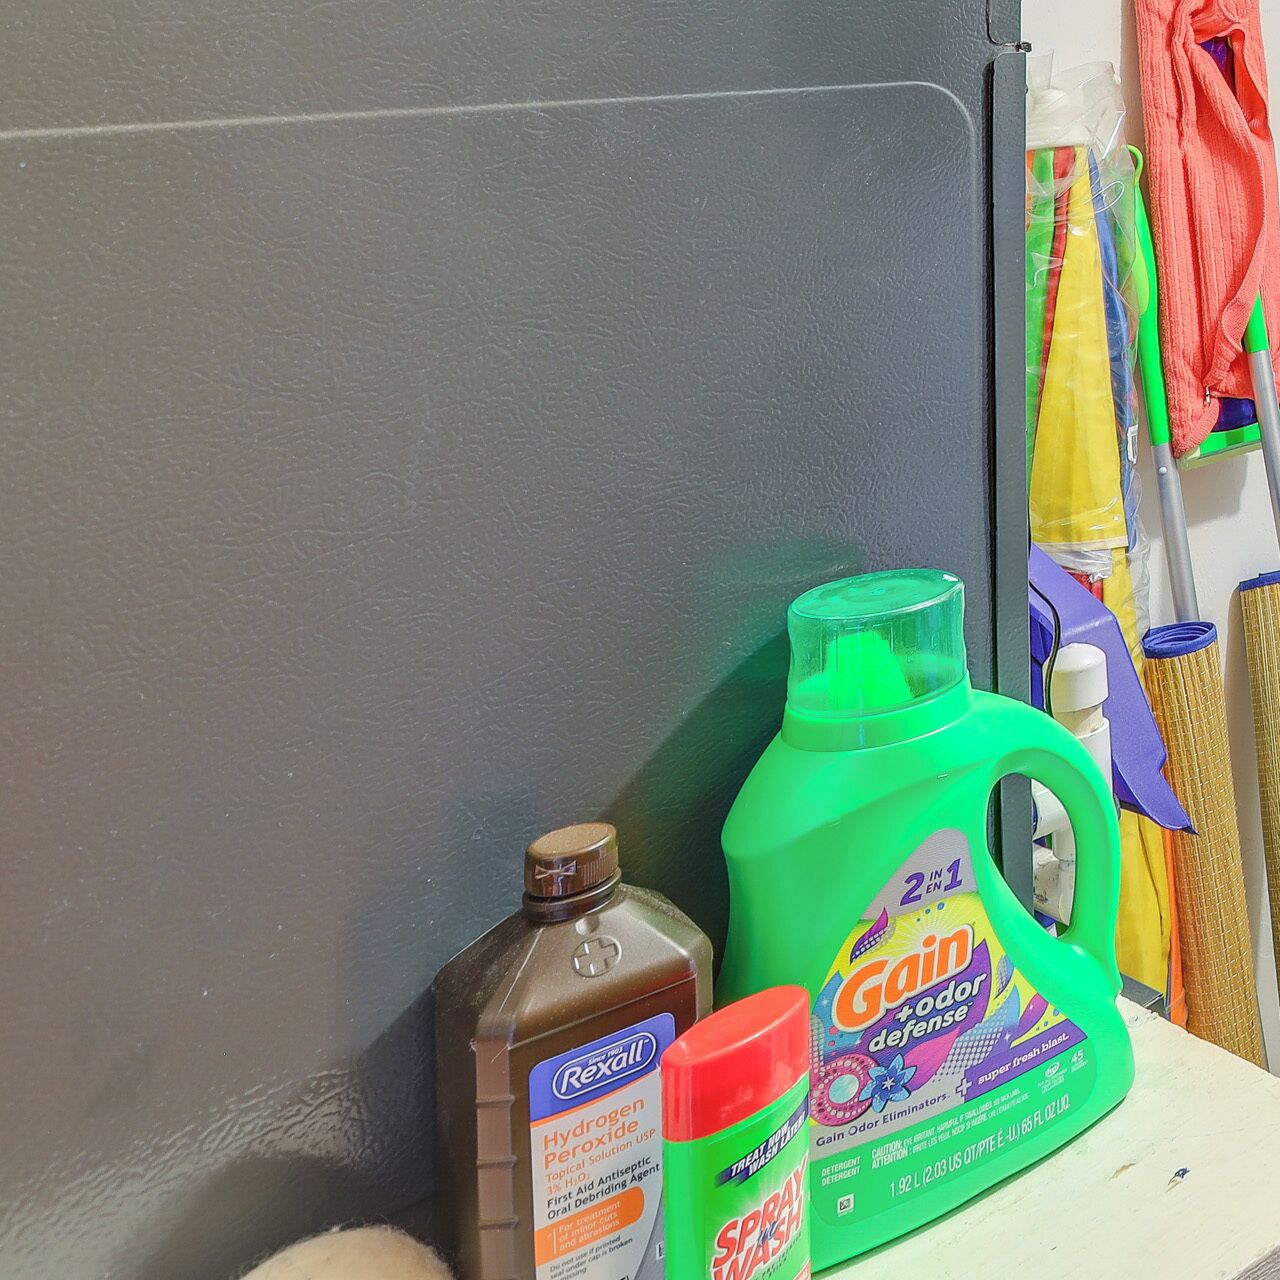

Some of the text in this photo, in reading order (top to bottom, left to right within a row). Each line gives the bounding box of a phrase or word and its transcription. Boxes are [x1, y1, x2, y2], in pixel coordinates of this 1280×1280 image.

[900, 871, 924, 906] 2
[926, 881, 942, 894] EN
[929, 868, 943, 882] IN
[944, 858, 963, 892] 1
[834, 926, 971, 1030] Gain
[868, 1004, 969, 1053] defense
[560, 1039, 644, 1094] Rexall
[978, 1063, 1013, 1084] super
[1011, 1047, 1041, 1068] fresh
[1071, 1049, 1084, 1064] 45
[544, 1098, 645, 1151] Hydrogen
[816, 1132, 845, 1147] Gain
[848, 1119, 880, 1136] Odor
[882, 1094, 947, 1124] Eliminators
[545, 1121, 640, 1170] Peroxide
[546, 1128, 656, 1183] Topical Solution USP
[730, 1144, 766, 1177] TREAT
[748, 1143, 778, 1176] WASH
[871, 1139, 902, 1159] CAUTION:
[871, 1146, 908, 1170] ATTENTION
[890, 1175, 912, 1198] 1.92
[914, 1172, 920, 1188] L
[922, 1159, 947, 1186] (2.03
[949, 1150, 961, 1171] US
[964, 1134, 996, 1165] QT/PTE
[1021, 1115, 1033, 1135] 65
[1034, 1110, 1044, 1128] FL
[1045, 1102, 1057, 1120] OZ
[547, 1156, 651, 1209] First Aid Antiseptic
[821, 1156, 861, 1177] DETERGENT
[546, 1183, 561, 1196] 3%
[547, 1163, 660, 1220] Oral Debriding Agent
[559, 1201, 621, 1232] For treatment
[559, 1212, 618, 1243] of minor cuts
[713, 1155, 808, 1269] SPRAY
[560, 1220, 620, 1251] and abrasions
[609, 1238, 633, 1254] broken
[713, 1196, 803, 1280] WASH
[550, 1264, 560, 1273] Do
[562, 1258, 574, 1268] not
[595, 1235, 621, 1254] printed
